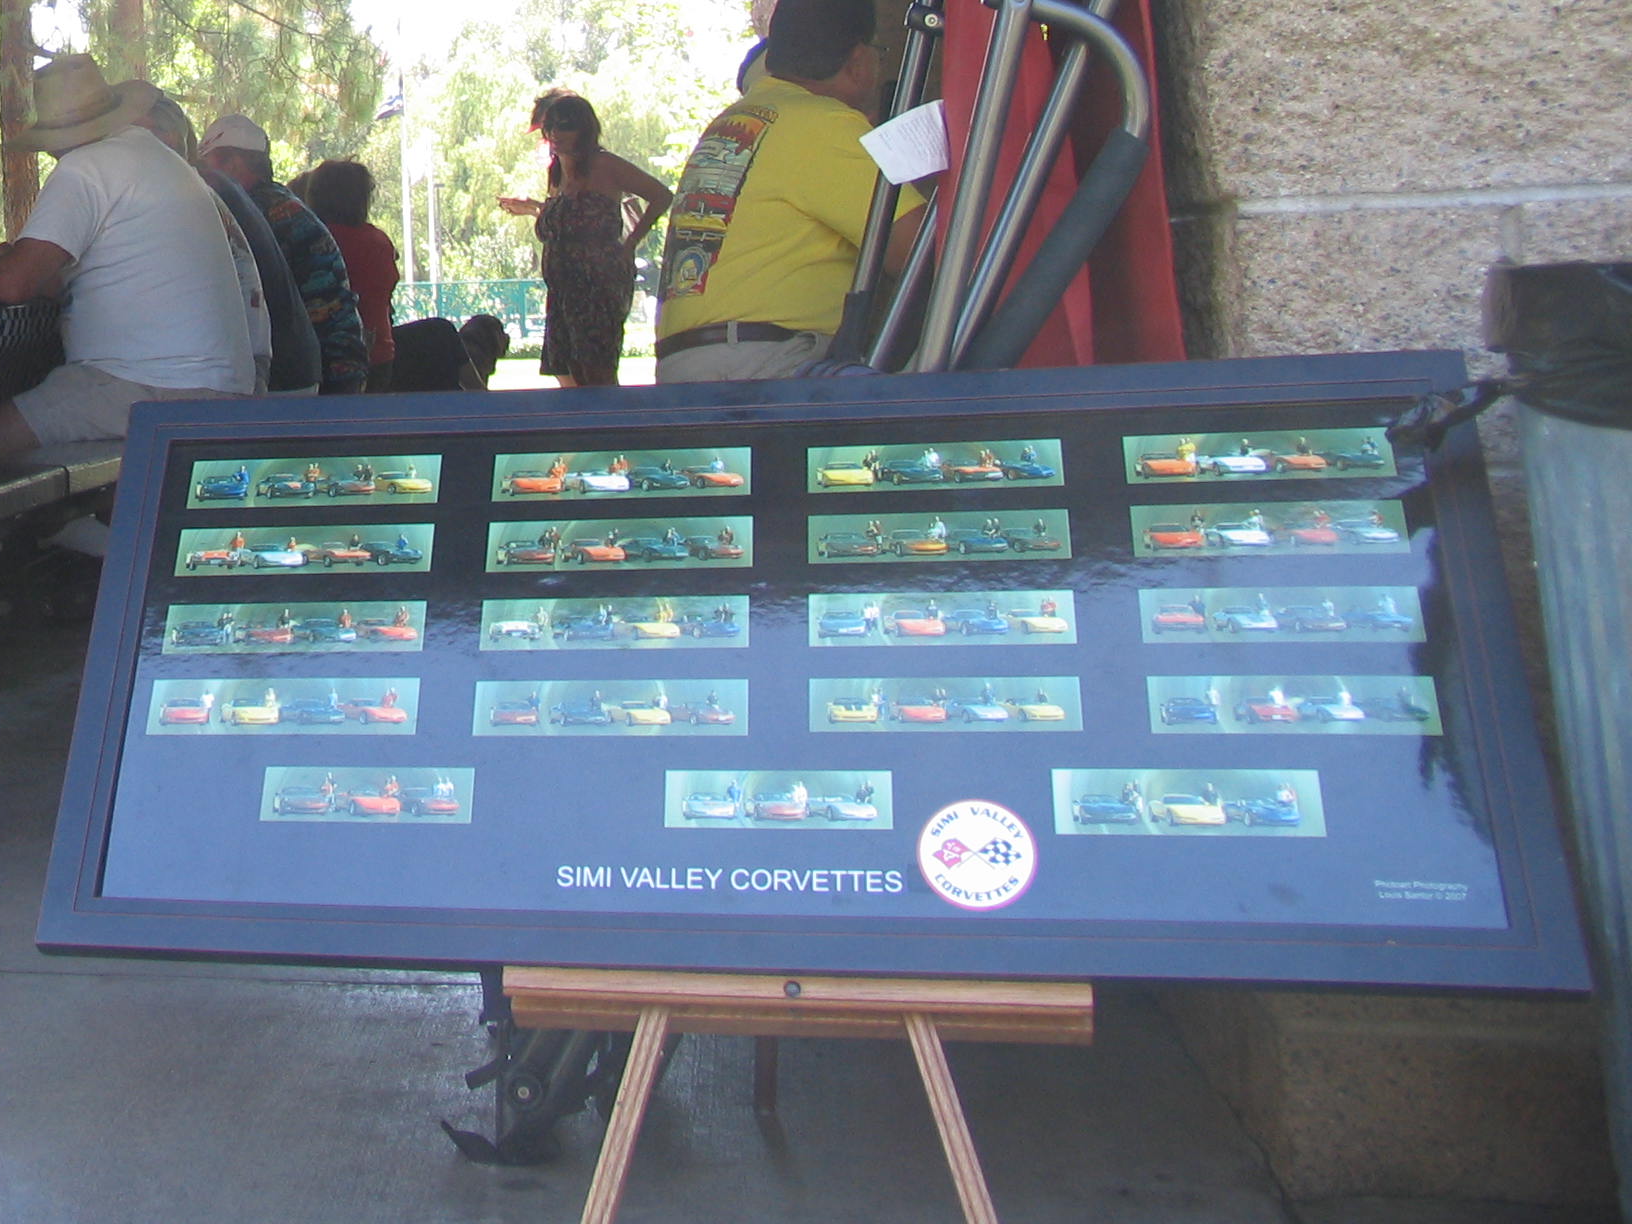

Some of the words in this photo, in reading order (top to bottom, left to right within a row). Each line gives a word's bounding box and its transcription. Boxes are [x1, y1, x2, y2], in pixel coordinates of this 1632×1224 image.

[931, 810, 959, 837] SIMI
[970, 806, 1024, 838] VALLEY
[555, 865, 612, 888] SIMI
[620, 867, 722, 890] VALLEY
[730, 869, 903, 893] CORVETTES
[935, 873, 1020, 902] CORVETTES
